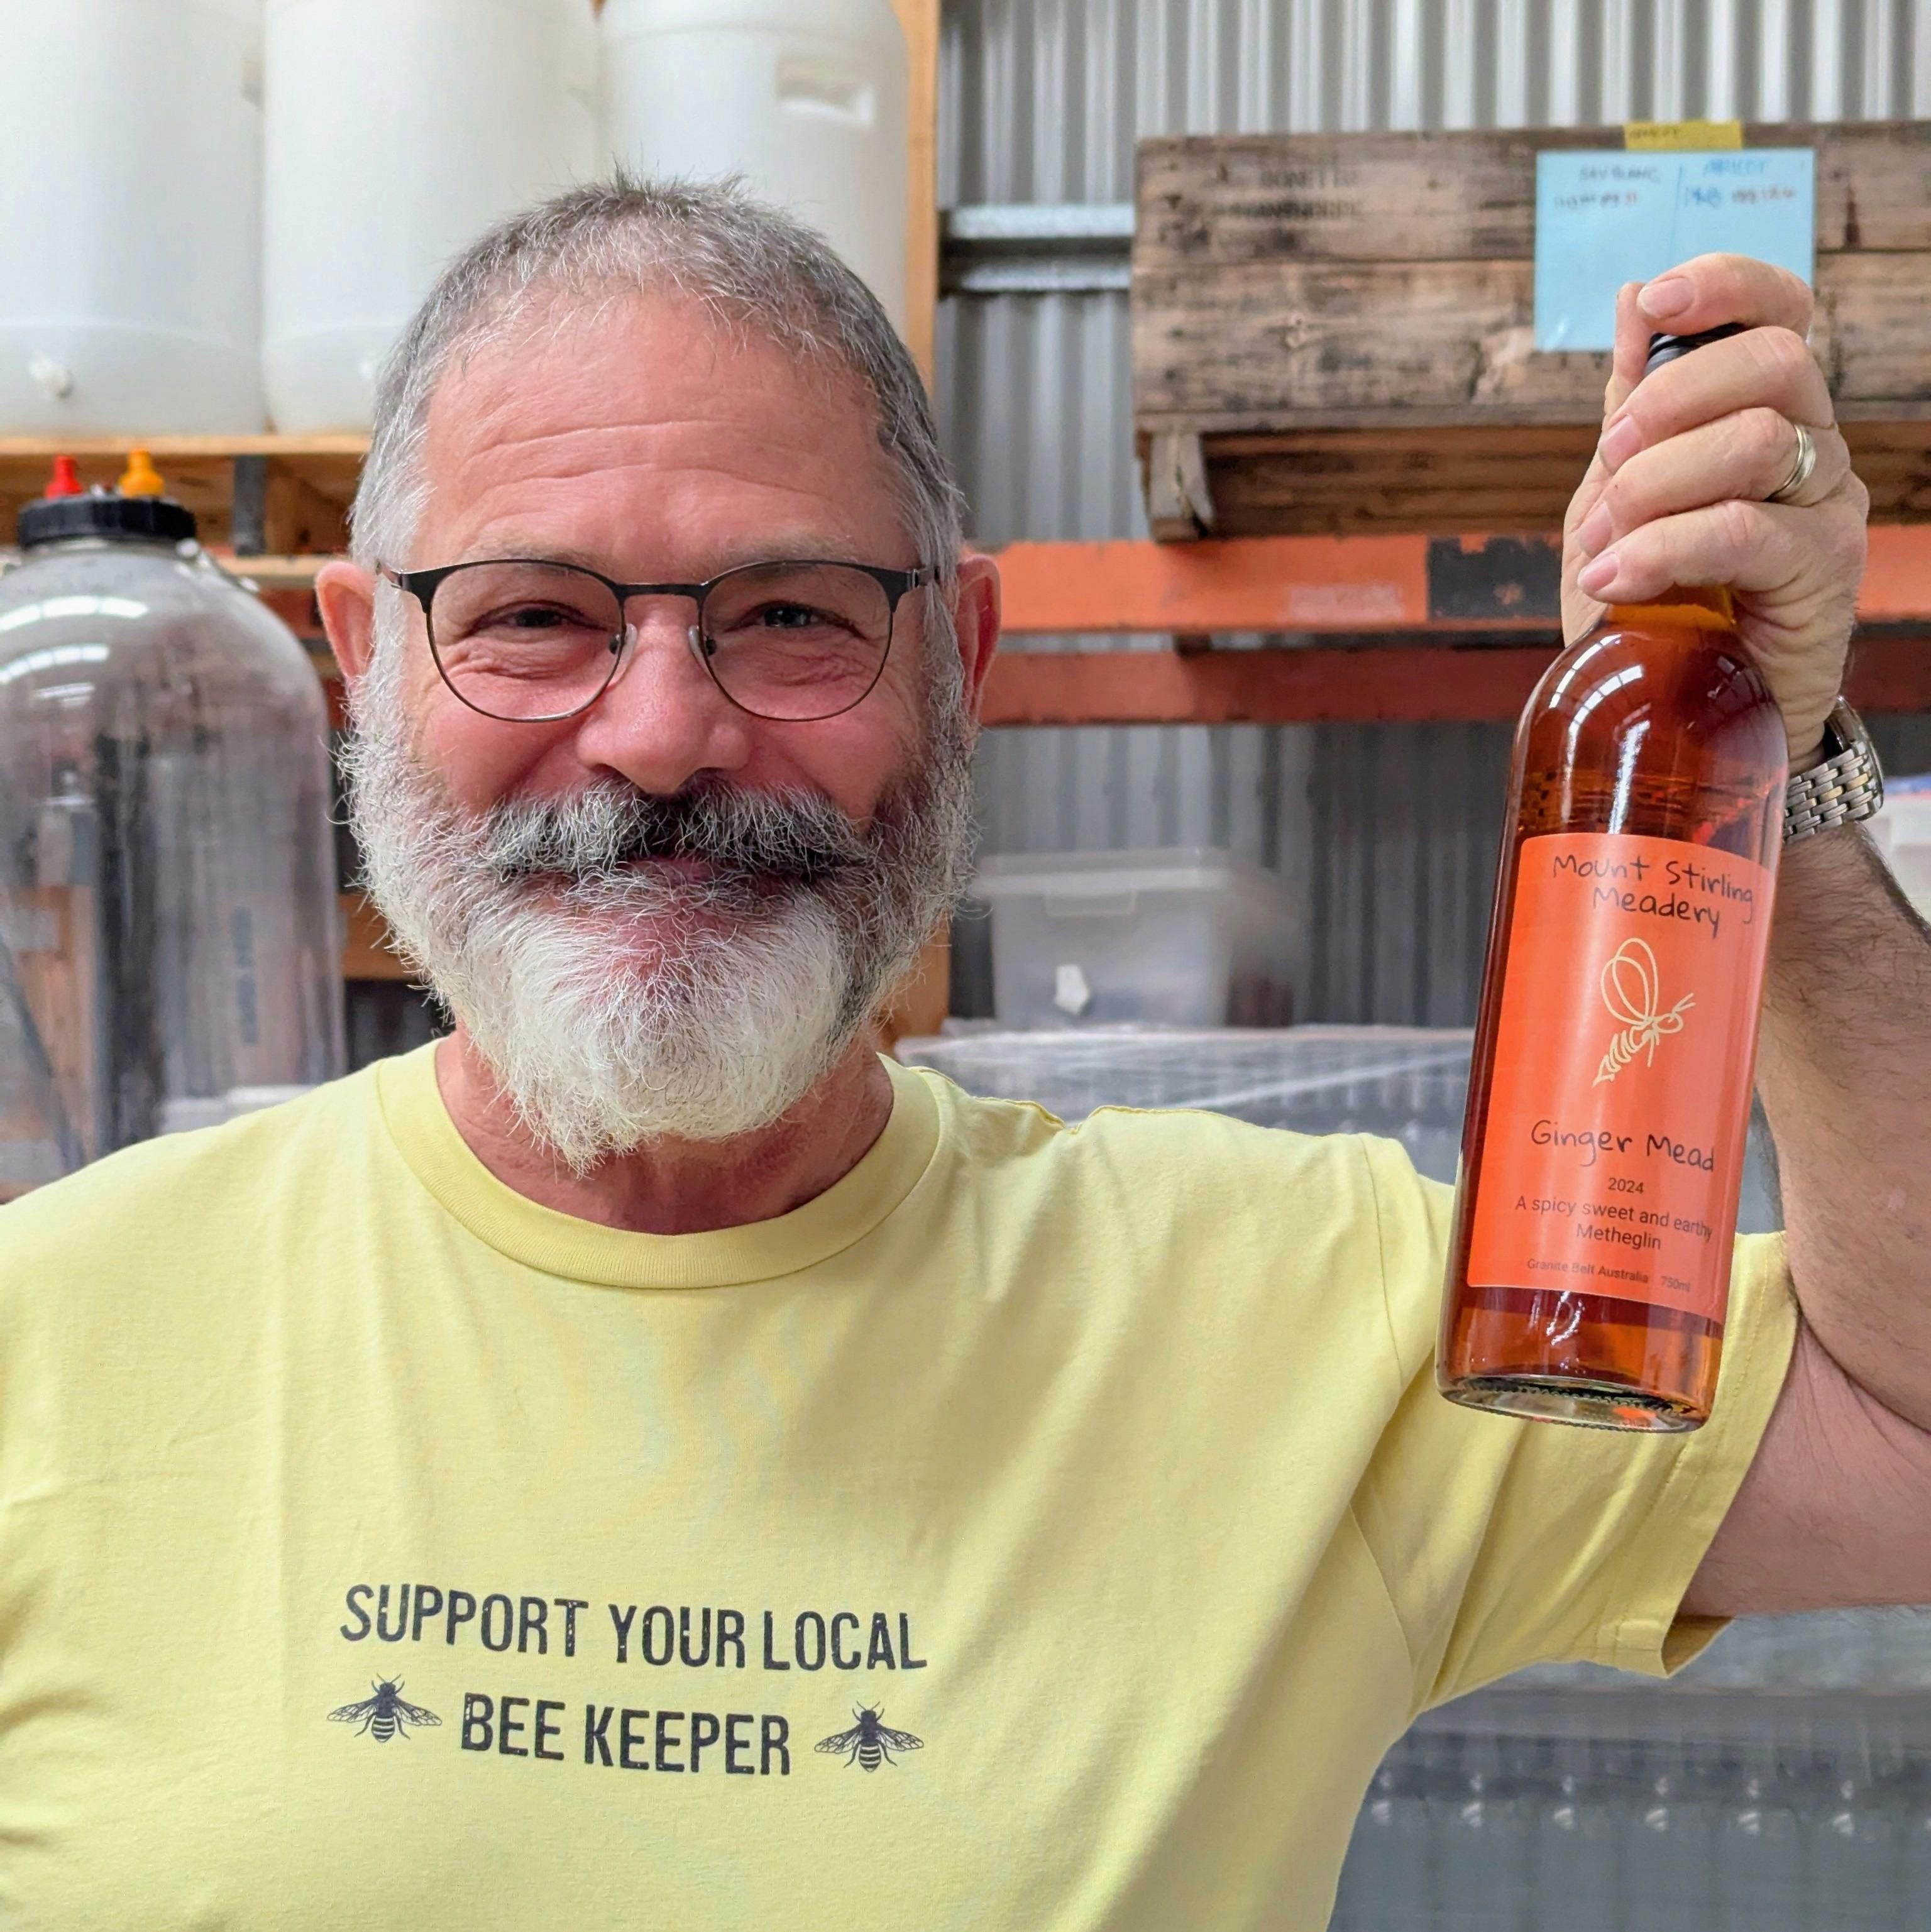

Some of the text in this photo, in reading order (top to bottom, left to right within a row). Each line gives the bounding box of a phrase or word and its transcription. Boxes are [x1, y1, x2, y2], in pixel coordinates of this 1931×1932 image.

[1553, 855, 1752, 924] Mount Stirling
[1593, 887, 1720, 938] Meadery
[1531, 1119, 1714, 1172] Ginger Mead
[1608, 1177, 1644, 1194] 2024
[1515, 1195, 1712, 1243] A spicy sweet and earthy
[1576, 1224, 1661, 1250] Metheglin
[1527, 1258, 1691, 1293] Granite Belt Australia 750ml
[340, 1584, 927, 1671] SUPPORT YOUR LOCAL
[461, 1692, 791, 1776] BEE KEEPER
